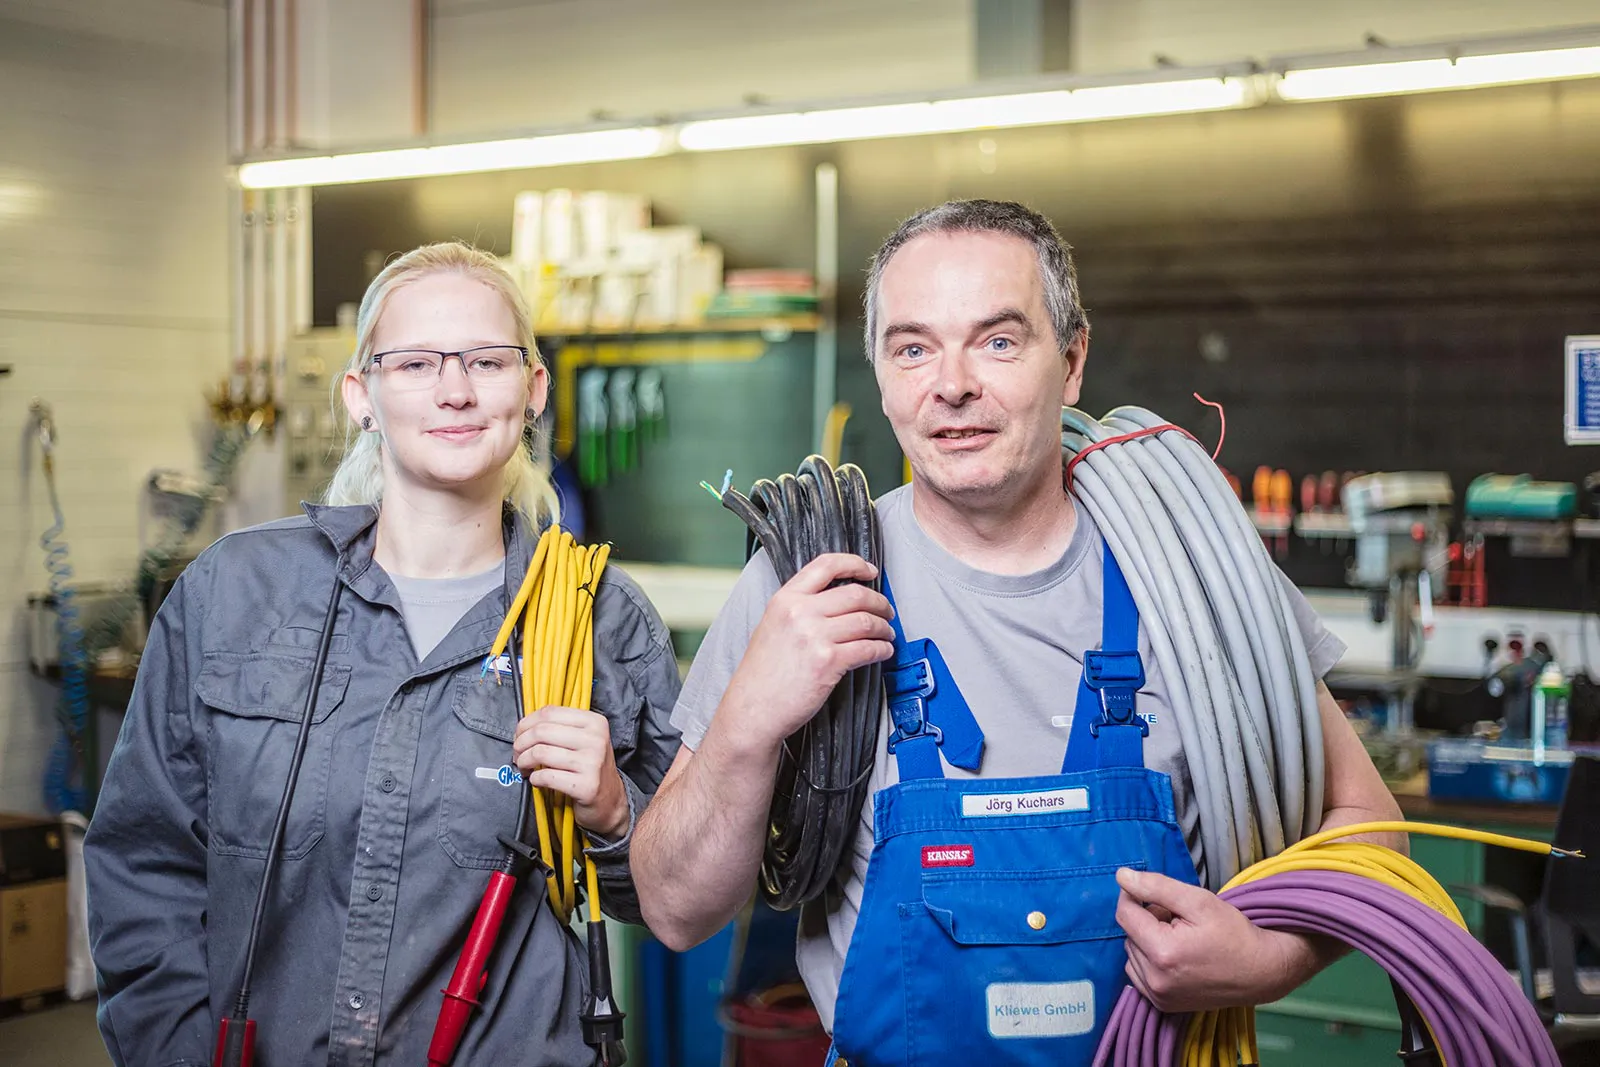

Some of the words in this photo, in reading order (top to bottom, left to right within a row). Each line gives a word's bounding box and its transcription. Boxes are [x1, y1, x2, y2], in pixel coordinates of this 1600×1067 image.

[986, 798, 1012, 812] Jörg
[1017, 796, 1065, 809] Kuchars
[995, 1004, 1040, 1017] Kliewe
[1044, 1001, 1087, 1016] GmbH
